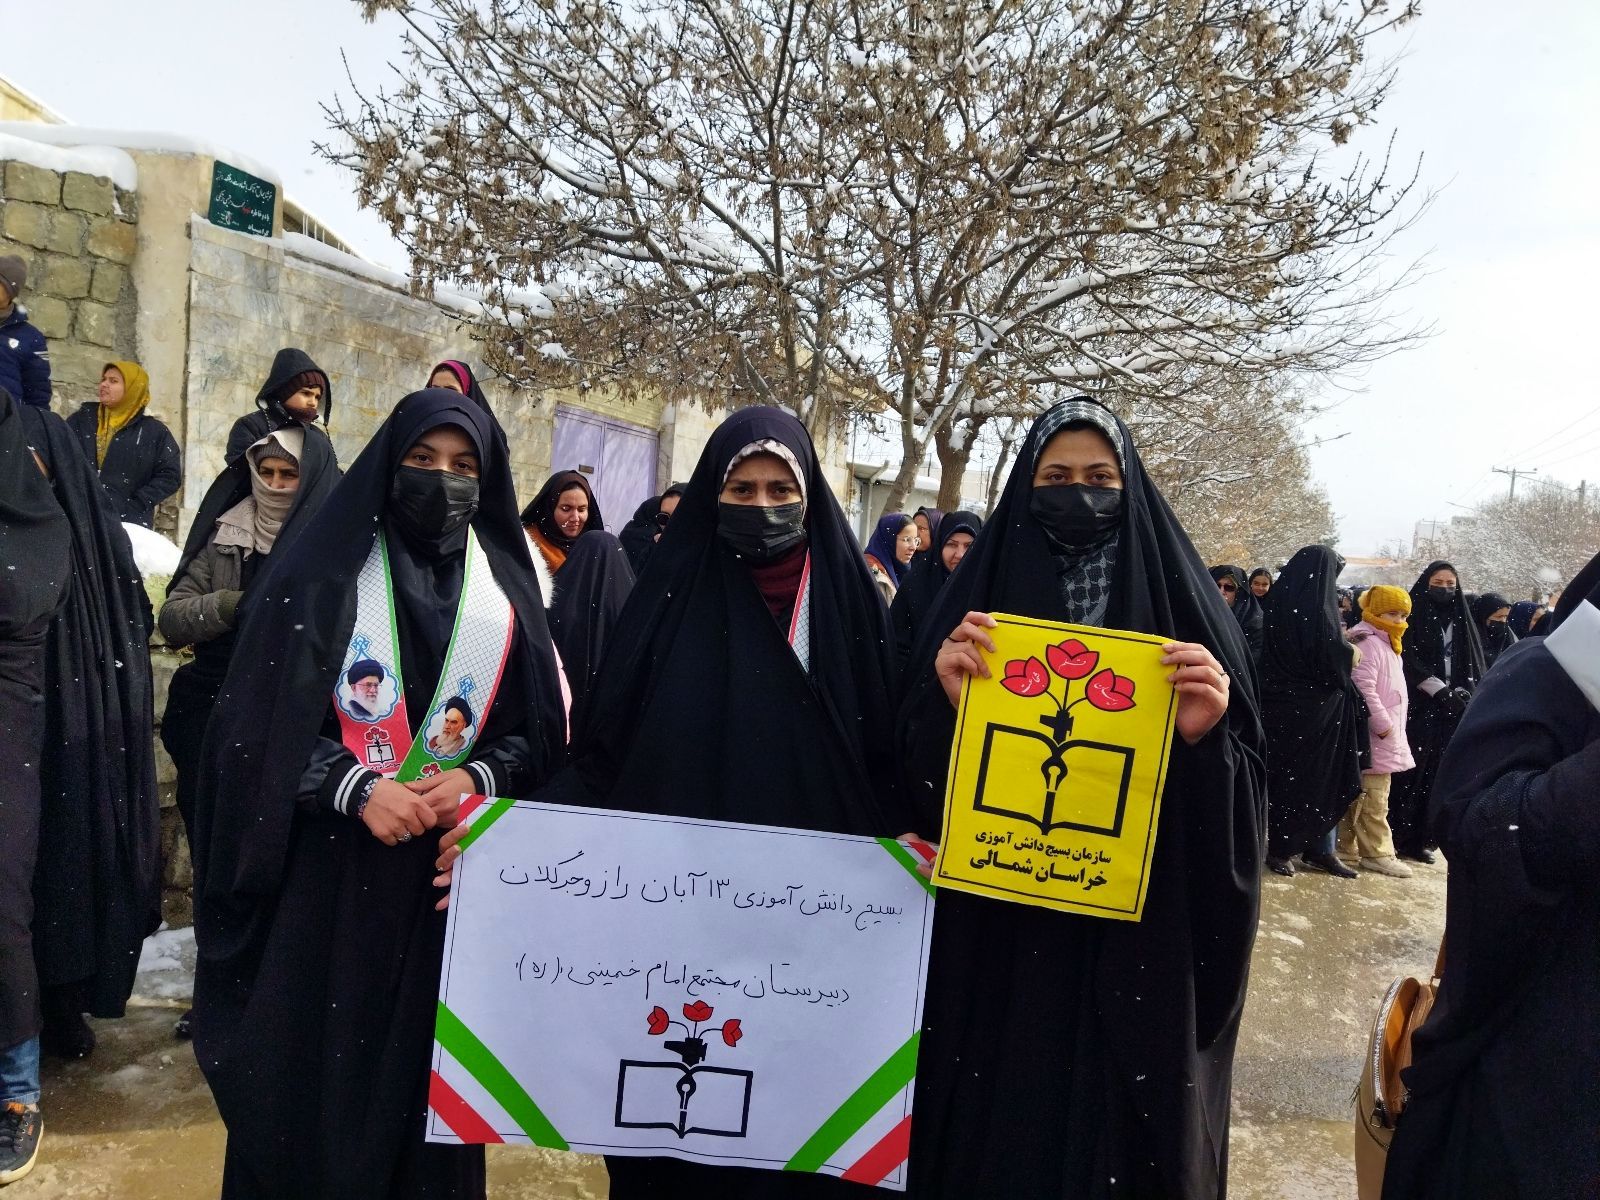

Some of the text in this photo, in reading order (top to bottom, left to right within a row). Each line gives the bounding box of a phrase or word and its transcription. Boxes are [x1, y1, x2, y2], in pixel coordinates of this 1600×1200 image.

[975, 831, 1111, 865] سازمان بسیج دانش آموزی
[969, 849, 1107, 891] خراسان شمالی
[641, 871, 708, 903] آبان
[709, 878, 730, 899] ۱۳
[733, 884, 804, 909] آموزی
[799, 890, 853, 916] دانش
[854, 903, 903, 931] بسیج
[567, 959, 641, 987] خمینی
[645, 960, 687, 1001] امام
[686, 968, 741, 996] مجتمع
[743, 962, 850, 1007] دبیرستان
